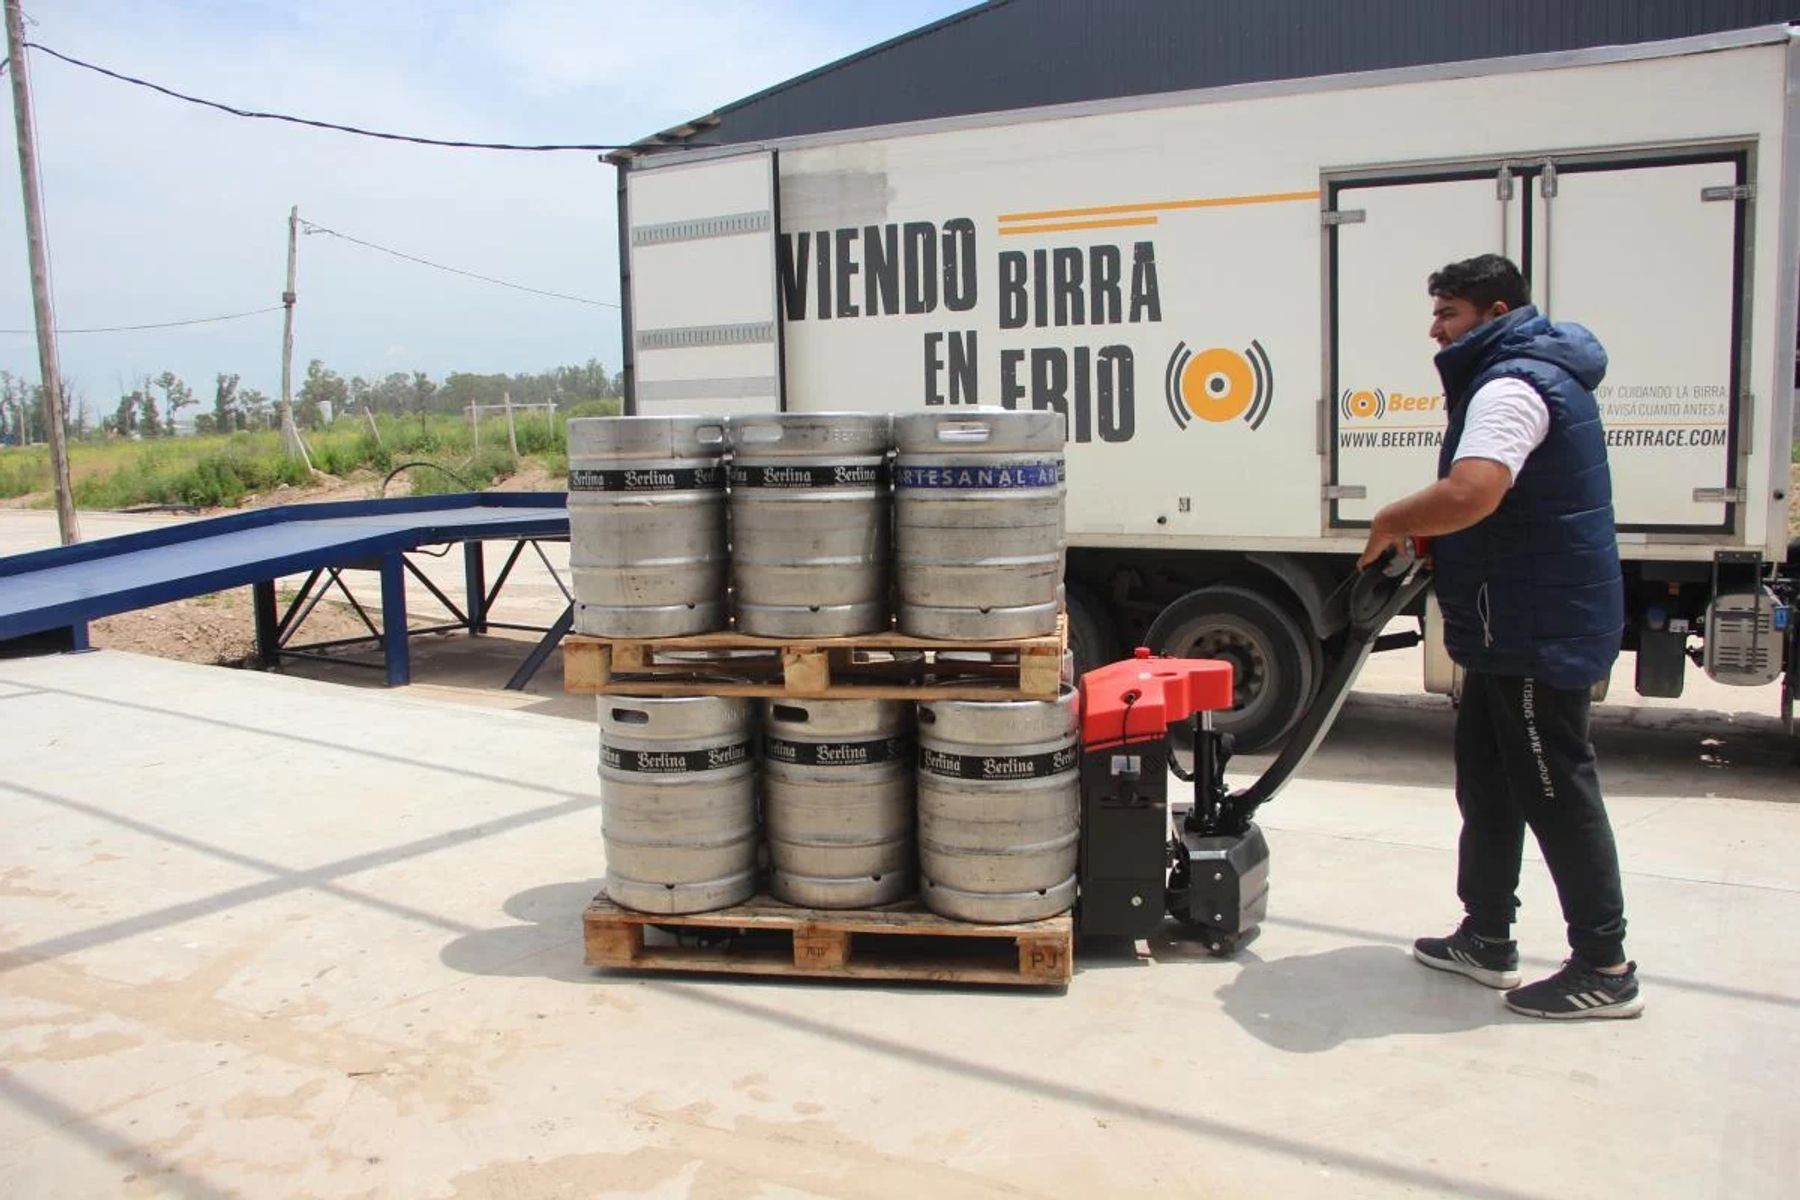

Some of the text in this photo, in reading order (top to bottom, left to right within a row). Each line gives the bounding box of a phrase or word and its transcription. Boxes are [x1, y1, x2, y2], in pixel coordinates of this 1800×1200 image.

[998, 241, 1163, 330] BIRRA
[924, 330, 1136, 444] EN FRIO
[1683, 403, 1717, 416] ANTES
[1603, 429, 1727, 447] EERTRACE.COM
[624, 470, 676, 486] Berlina
[763, 467, 812, 483] Berlina
[833, 466, 876, 482] Berlina
[898, 468, 1027, 486] RTESANAL
[638, 751, 686, 767] Berlina
[816, 743, 867, 760] Berlina
[982, 758, 1034, 774] Berlina
